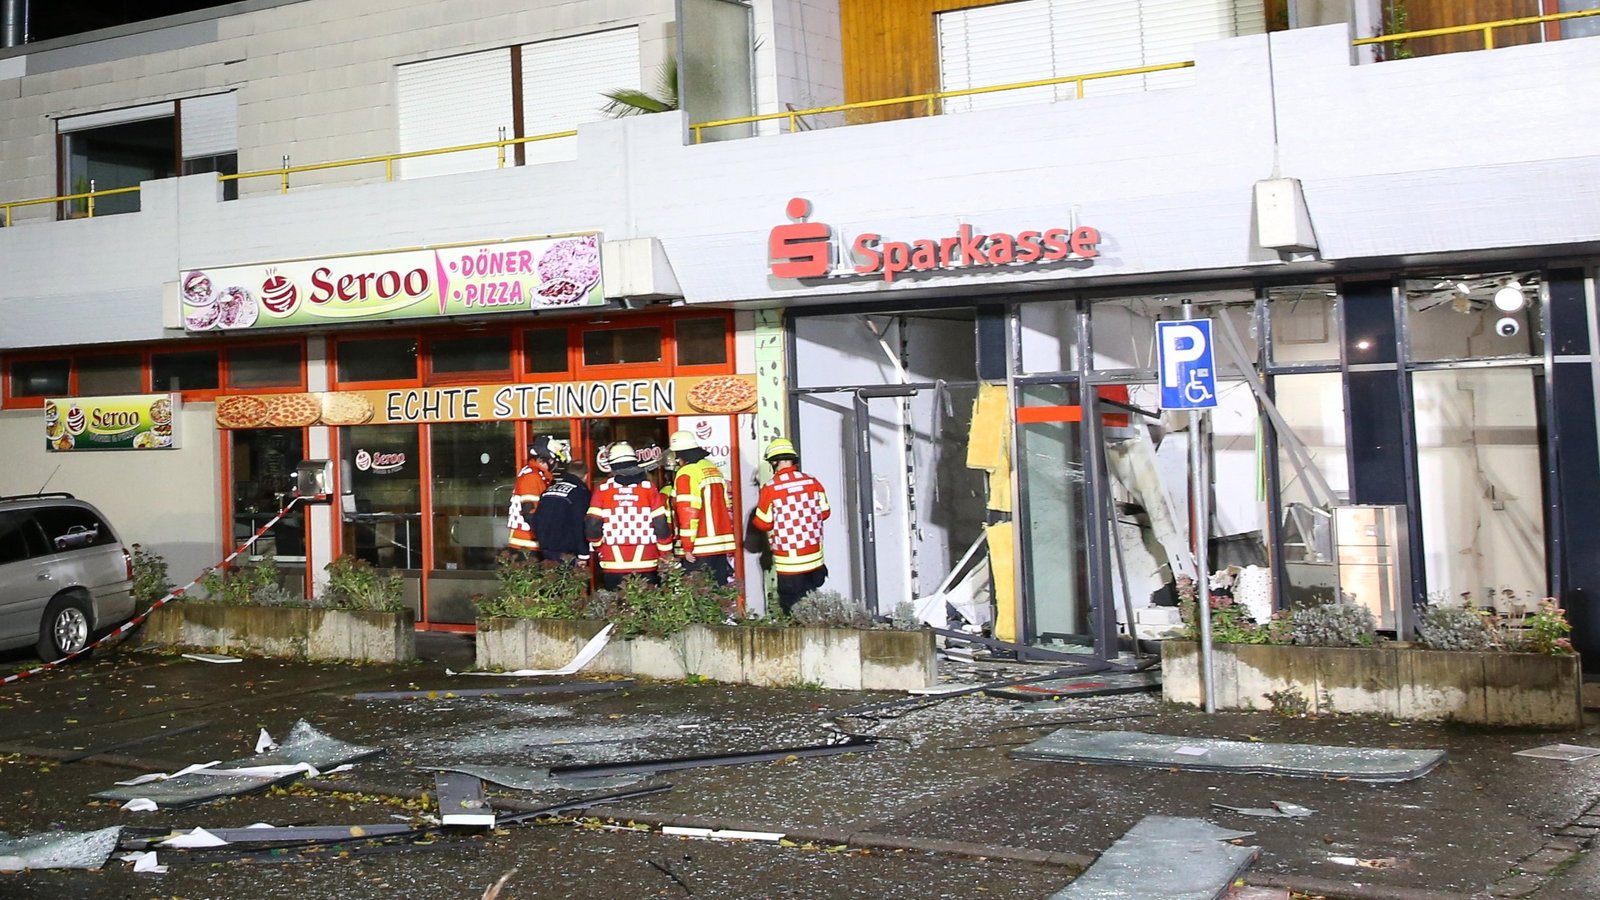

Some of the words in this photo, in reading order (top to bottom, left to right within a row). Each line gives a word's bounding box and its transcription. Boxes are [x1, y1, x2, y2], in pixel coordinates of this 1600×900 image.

[461, 248, 534, 278] DÖNER
[854, 224, 1100, 282] Sparkasse
[309, 266, 430, 305] Seroo
[464, 281, 524, 307] PIZZA
[1162, 325, 1206, 387] P
[387, 388, 479, 422] ECHTE
[493, 379, 675, 417] STEINOFEN
[91, 407, 140, 428] Seroo
[373, 451, 406, 466] Seroo
[635, 446, 662, 463] roo
